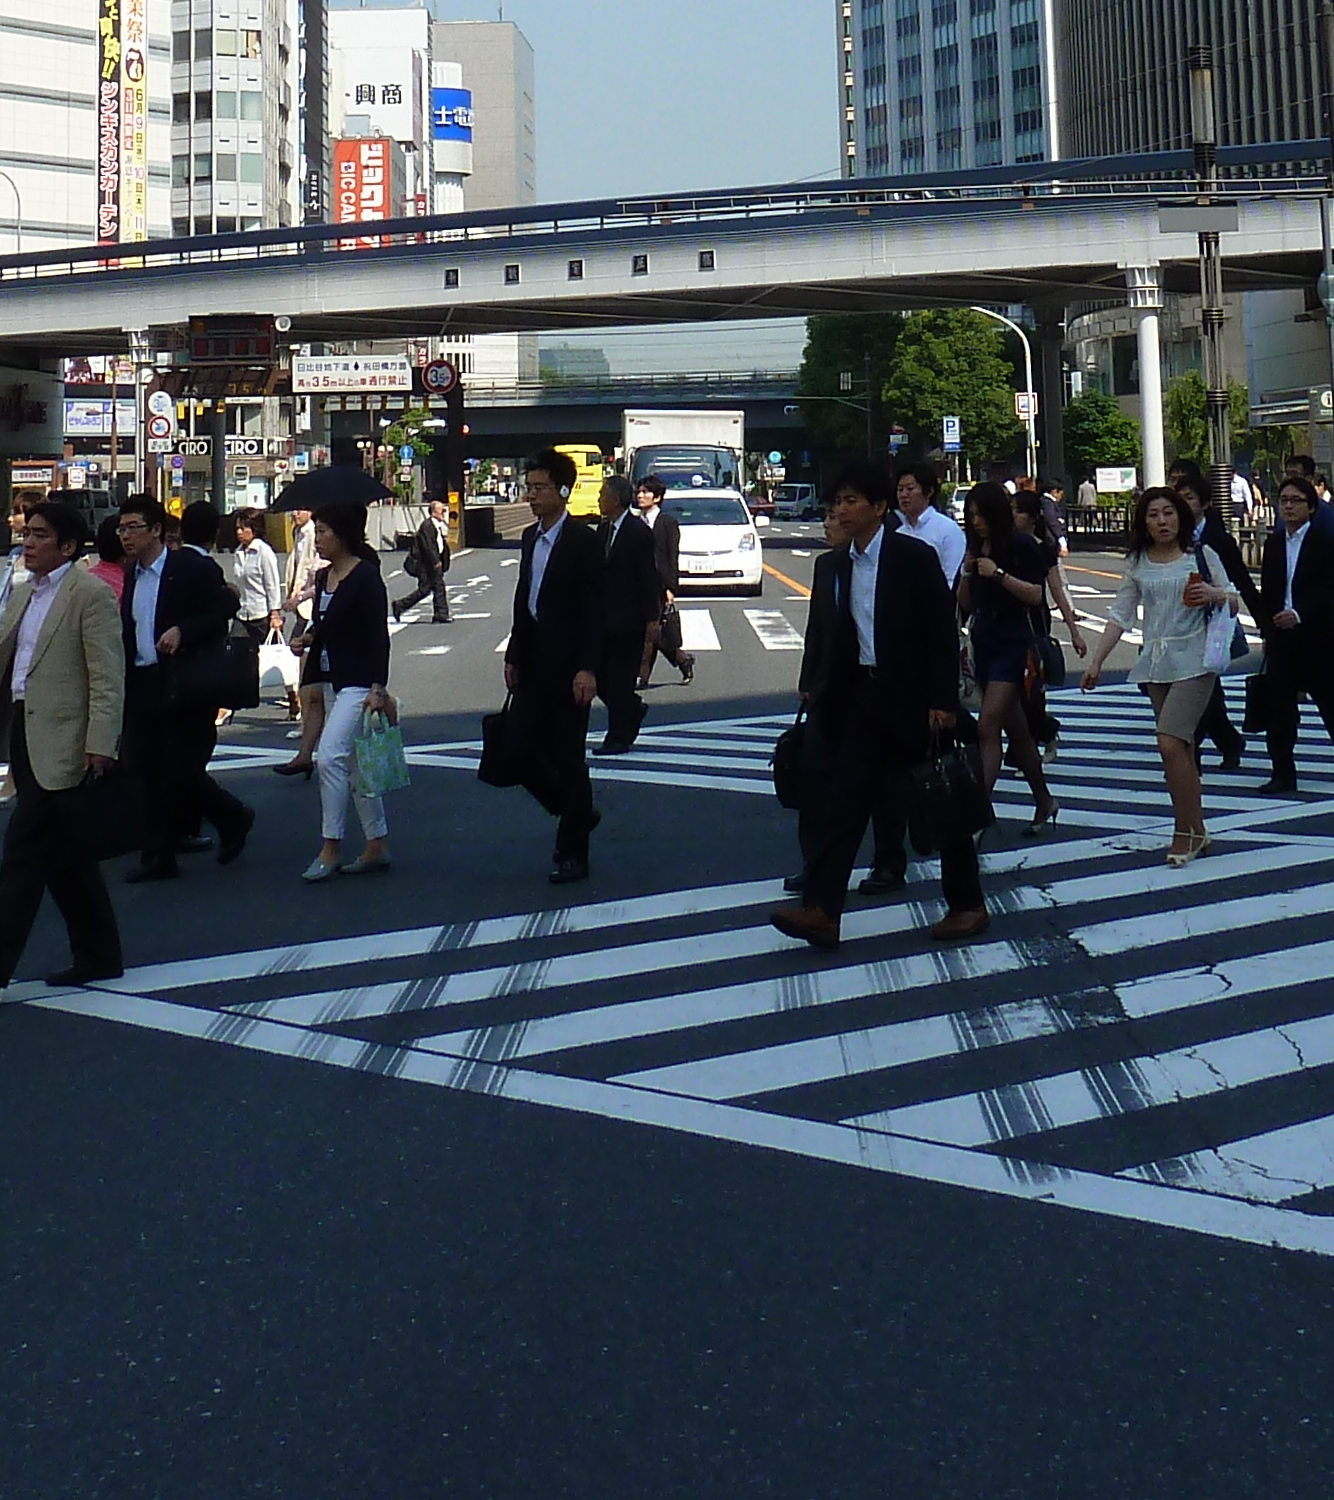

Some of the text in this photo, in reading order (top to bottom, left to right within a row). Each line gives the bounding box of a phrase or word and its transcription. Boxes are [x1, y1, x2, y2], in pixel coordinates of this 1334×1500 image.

[434, 105, 475, 128] 士電
[340, 161, 357, 190] BIC
[297, 361, 350, 373] 日比谷地下道
[178, 441, 208, 455] CIRO
